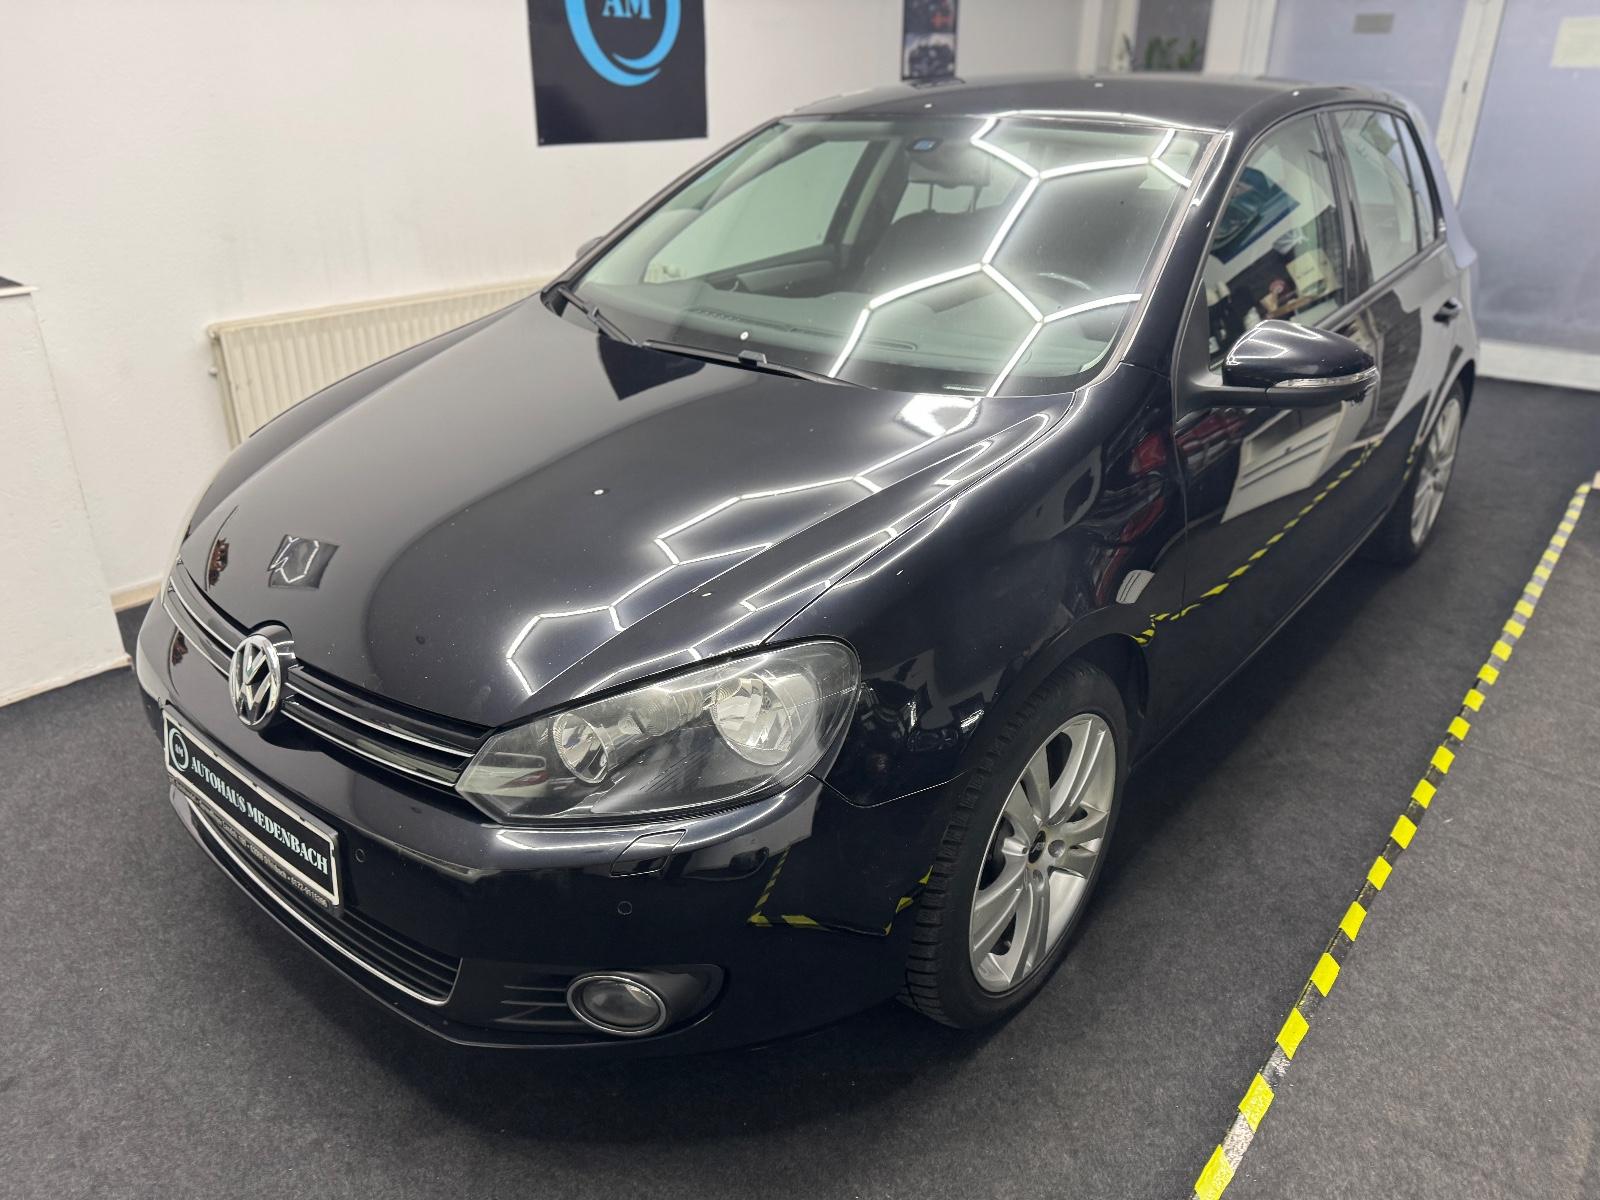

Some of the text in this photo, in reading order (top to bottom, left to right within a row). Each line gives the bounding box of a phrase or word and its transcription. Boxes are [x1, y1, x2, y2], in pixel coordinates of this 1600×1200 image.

[602, 0, 652, 20] AM
[191, 756, 246, 812] AUTOHAUS
[246, 801, 329, 875] MEDENBACH
